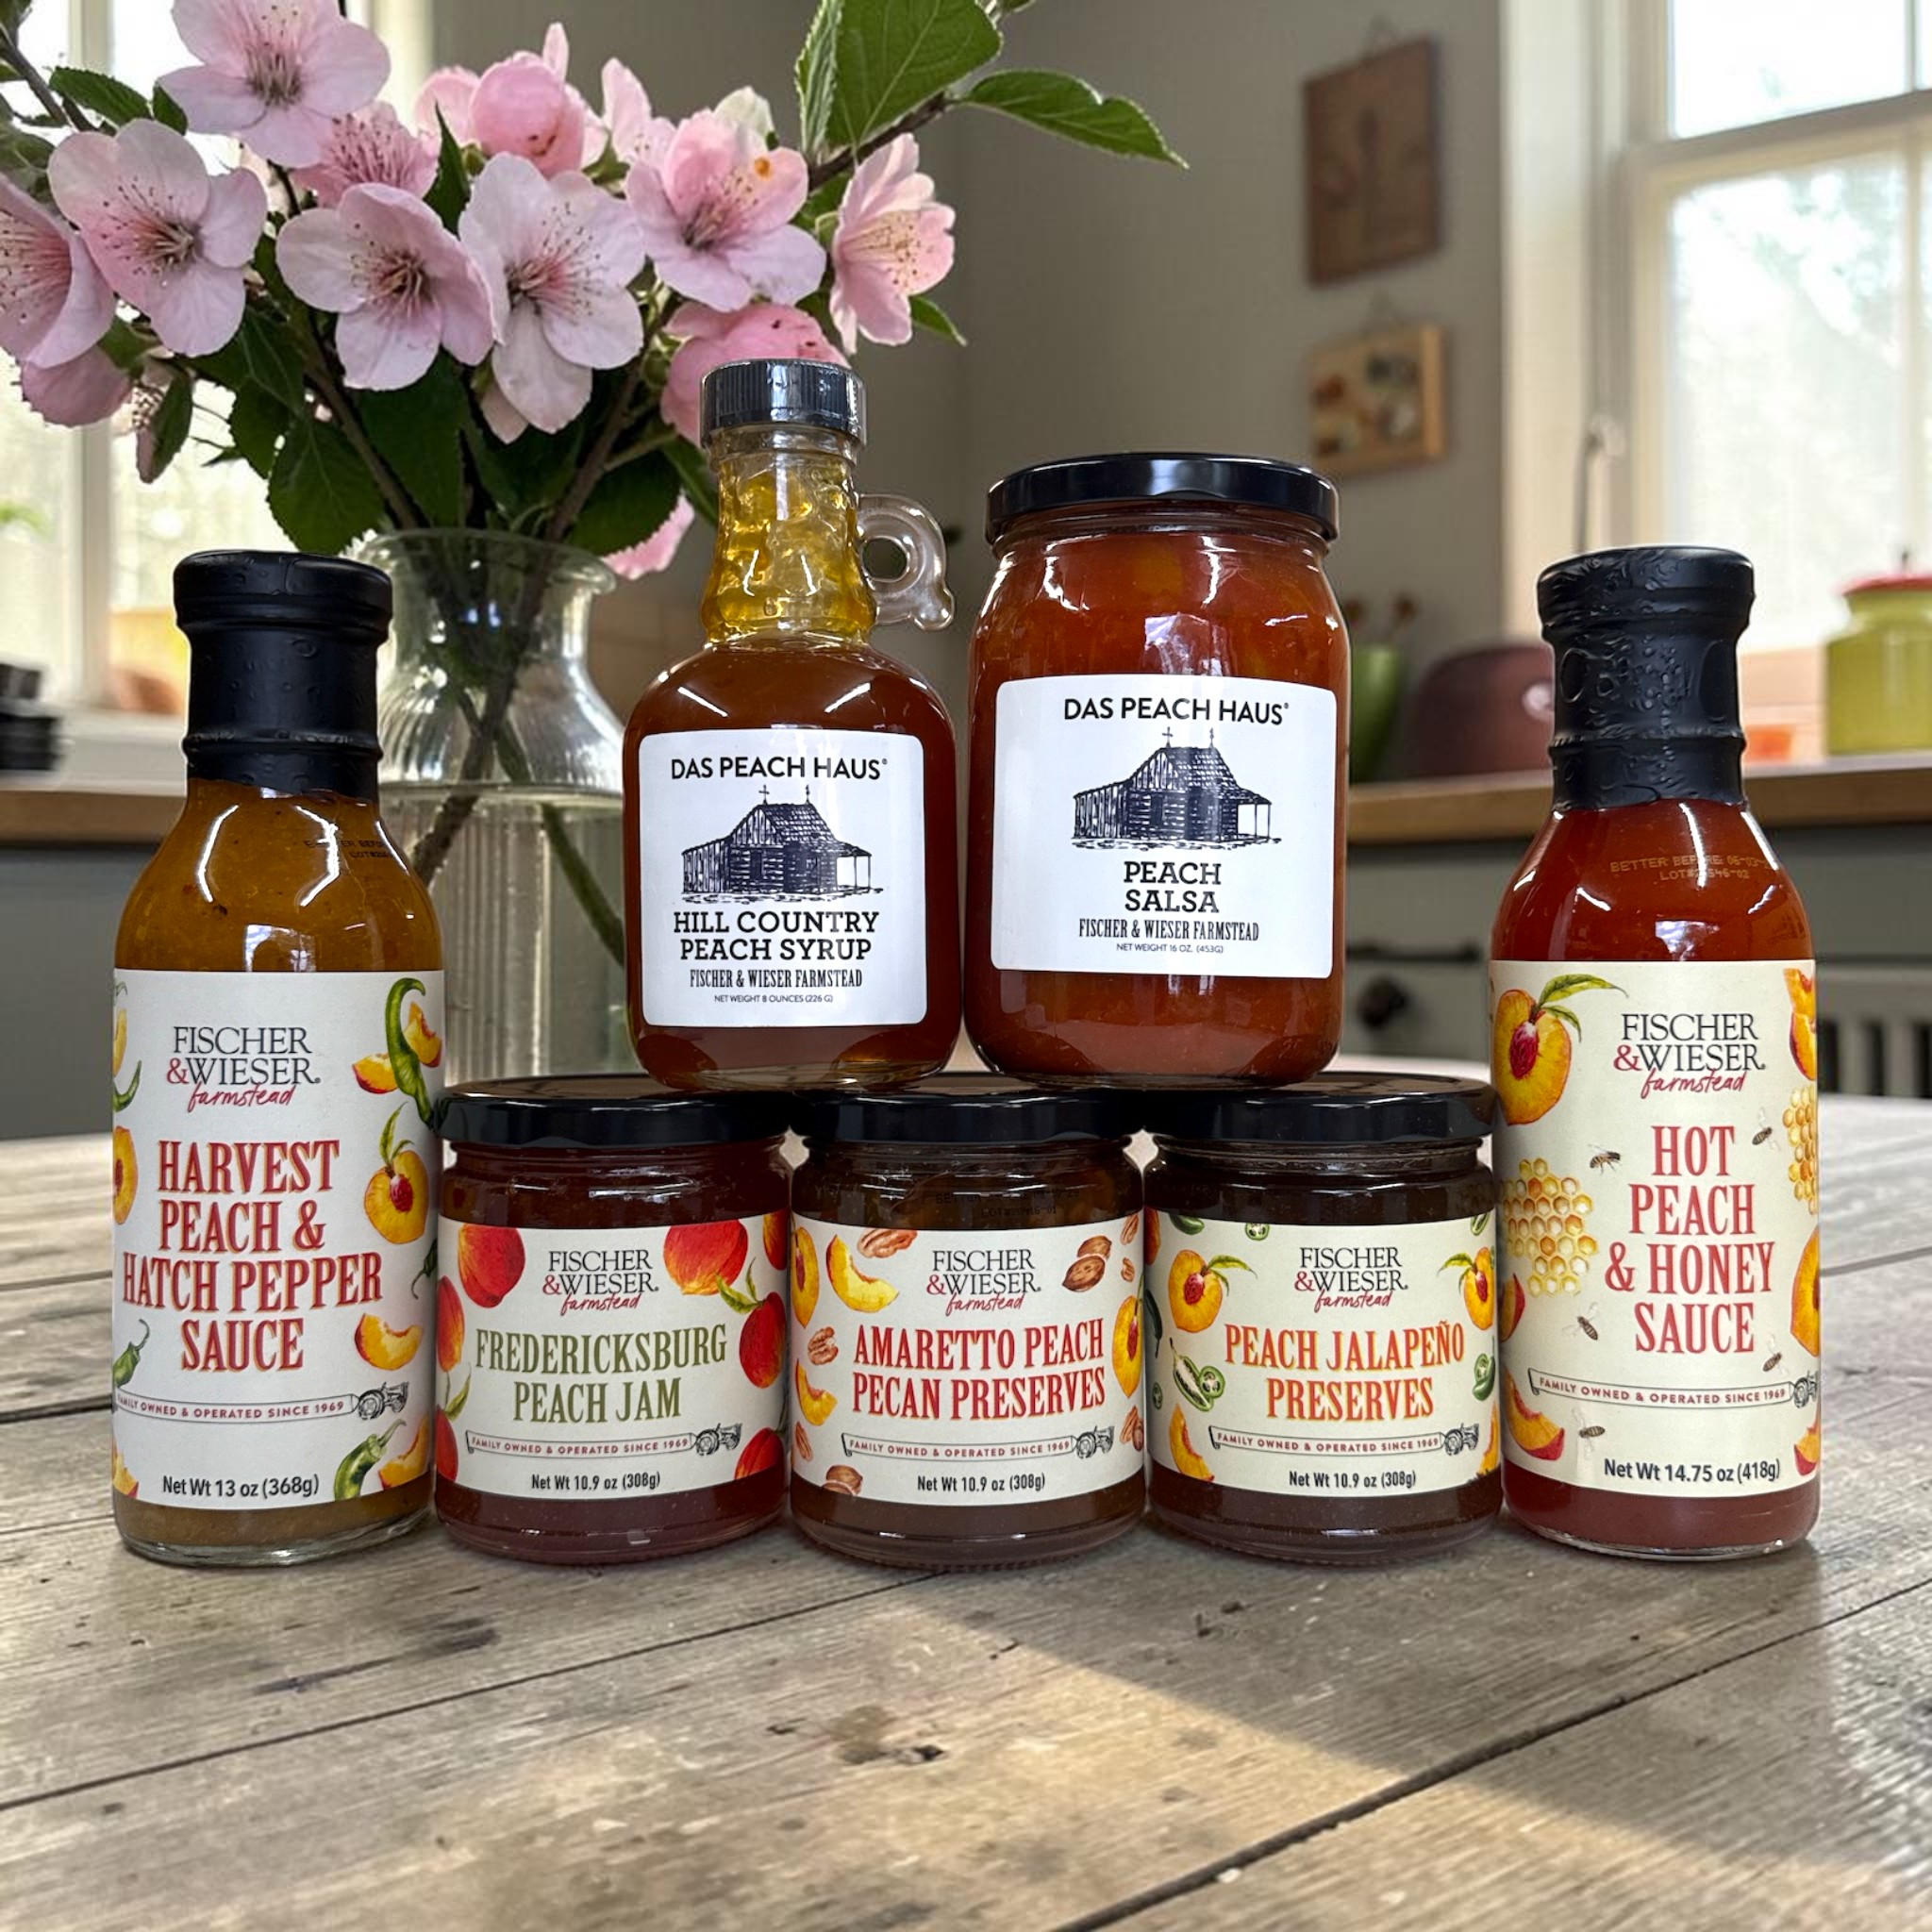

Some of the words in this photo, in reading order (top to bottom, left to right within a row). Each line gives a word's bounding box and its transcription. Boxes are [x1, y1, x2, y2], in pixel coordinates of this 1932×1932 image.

[1064, 698, 1113, 720] DAS
[1121, 698, 1210, 720] PEACH
[672, 758, 713, 779] DAS
[720, 757, 805, 777] PEACH
[1124, 861, 1221, 885] PEACH
[1610, 858, 1668, 873] BETTER
[1673, 855, 1724, 866] BEFRE:
[1659, 868, 1749, 880] LOT#2546-02
[1125, 890, 1220, 913] SALSA
[674, 911, 729, 932] HILL
[737, 911, 879, 933] COUNTRY
[1079, 919, 1127, 939] FISCHER
[1132, 921, 1140, 938] &
[1144, 920, 1190, 940] WIESER
[1193, 921, 1259, 941] FARMSTEAD
[680, 939, 772, 960] PEACH
[780, 940, 872, 960] SYRUP
[690, 969, 733, 988] FISCHER
[737, 970, 744, 987] &
[748, 969, 791, 988] WIESER
[795, 969, 862, 988] FARMSTEAD
[1622, 1013, 1758, 1041] FISCHER
[174, 1026, 312, 1055] FISCHER
[1613, 1043, 1766, 1072] &WIESER
[167, 1058, 321, 1085] &WIESER
[1641, 1068, 1747, 1099] farmstead
[188, 1081, 295, 1113] farmstead
[1651, 1124, 1735, 1177] HOT
[158, 1140, 340, 1194] HARVEST
[1628, 1184, 1757, 1236] PEACH
[158, 1200, 282, 1253] PEACH
[294, 1200, 325, 1250] &
[548, 1249, 653, 1272] FISCHER
[932, 1249, 1036, 1272] FISCHER
[1300, 1247, 1403, 1269] FISCHER
[1605, 1241, 1636, 1292] &
[1649, 1241, 1774, 1296] HONEY
[123, 1251, 220, 1313] HATCH
[230, 1251, 383, 1313] PEPPER
[542, 1273, 659, 1295] &WIESER
[926, 1273, 1041, 1294] &WIESER
[1294, 1270, 1407, 1292] &WIESER
[560, 1293, 641, 1316] farmstead
[945, 1293, 1024, 1316] farmstead
[1314, 1290, 1393, 1312] farmstead
[1634, 1302, 1756, 1354] SAUCE
[181, 1319, 304, 1372] SAUCE
[475, 1324, 727, 1374] FREDERICKSBURG
[854, 1324, 1015, 1369] AMARETTO
[1024, 1318, 1104, 1368] PEACH
[1224, 1324, 1319, 1370] PEACH
[1325, 1320, 1464, 1371] JALAPEÑO
[513, 1381, 608, 1423] PEACH
[616, 1377, 681, 1422] JAM
[853, 1372, 941, 1419] PECAN
[951, 1366, 1106, 1420] PRESERVES
[1267, 1376, 1434, 1422] PRESERVES
[1540, 1377, 1576, 1393] FAMILY
[1581, 1387, 1629, 1401] OWNED
[1636, 1392, 1643, 1402] &
[1651, 1392, 1719, 1404] OPERATED
[1725, 1391, 1760, 1403] SINCE
[1763, 1389, 1785, 1400] 1969
[142, 1403, 176, 1415] OWNED
[193, 1408, 261, 1419] OPERATED
[268, 1406, 308, 1418] SINCE
[315, 1401, 343, 1413] 1969
[472, 1436, 501, 1450] FAMILY
[505, 1443, 541, 1454] OWNED
[546, 1445, 554, 1454] &
[558, 1444, 618, 1455] OPERATED
[625, 1441, 658, 1452] SINCE
[663, 1438, 688, 1449] 1969
[850, 1440, 884, 1453] FAMILY
[888, 1445, 927, 1456] OWNED
[944, 1447, 1005, 1457] OPERATED
[1010, 1443, 1042, 1456] SINCE
[1047, 1441, 1070, 1452] 1969
[1217, 1432, 1253, 1447] FAMILY
[1257, 1438, 1299, 1451] OWNED
[1304, 1442, 1311, 1451] &
[1316, 1442, 1376, 1452] OPERATED
[1381, 1440, 1412, 1451] SINCE
[1417, 1438, 1439, 1448] 1969
[531, 1474, 551, 1490] Net
[555, 1475, 570, 1490] Wt
[575, 1475, 599, 1490] 10.9
[605, 1477, 617, 1489] oz
[623, 1472, 660, 1489] (308g)
[917, 1475, 937, 1491] Net
[941, 1476, 957, 1491] Wt
[961, 1476, 987, 1491] 10.9
[991, 1479, 1005, 1491] oz
[1009, 1473, 1045, 1491] (308g)
[1289, 1471, 1309, 1487] Net
[1313, 1473, 1330, 1488] Wt
[1334, 1473, 1359, 1488] 10.9
[1364, 1476, 1376, 1488] oz
[1381, 1471, 1415, 1489] (308g)
[1604, 1457, 1631, 1478] Net
[1634, 1460, 1661, 1480] Wt
[1664, 1461, 1712, 1483] 14.75
[1717, 1466, 1735, 1481] oz
[1737, 1458, 1781, 1484] (418g)
[162, 1475, 187, 1493] Net
[190, 1477, 211, 1496] Wt
[215, 1480, 235, 1497] 13
[238, 1483, 258, 1497] oz
[262, 1474, 319, 1498] (368g)
